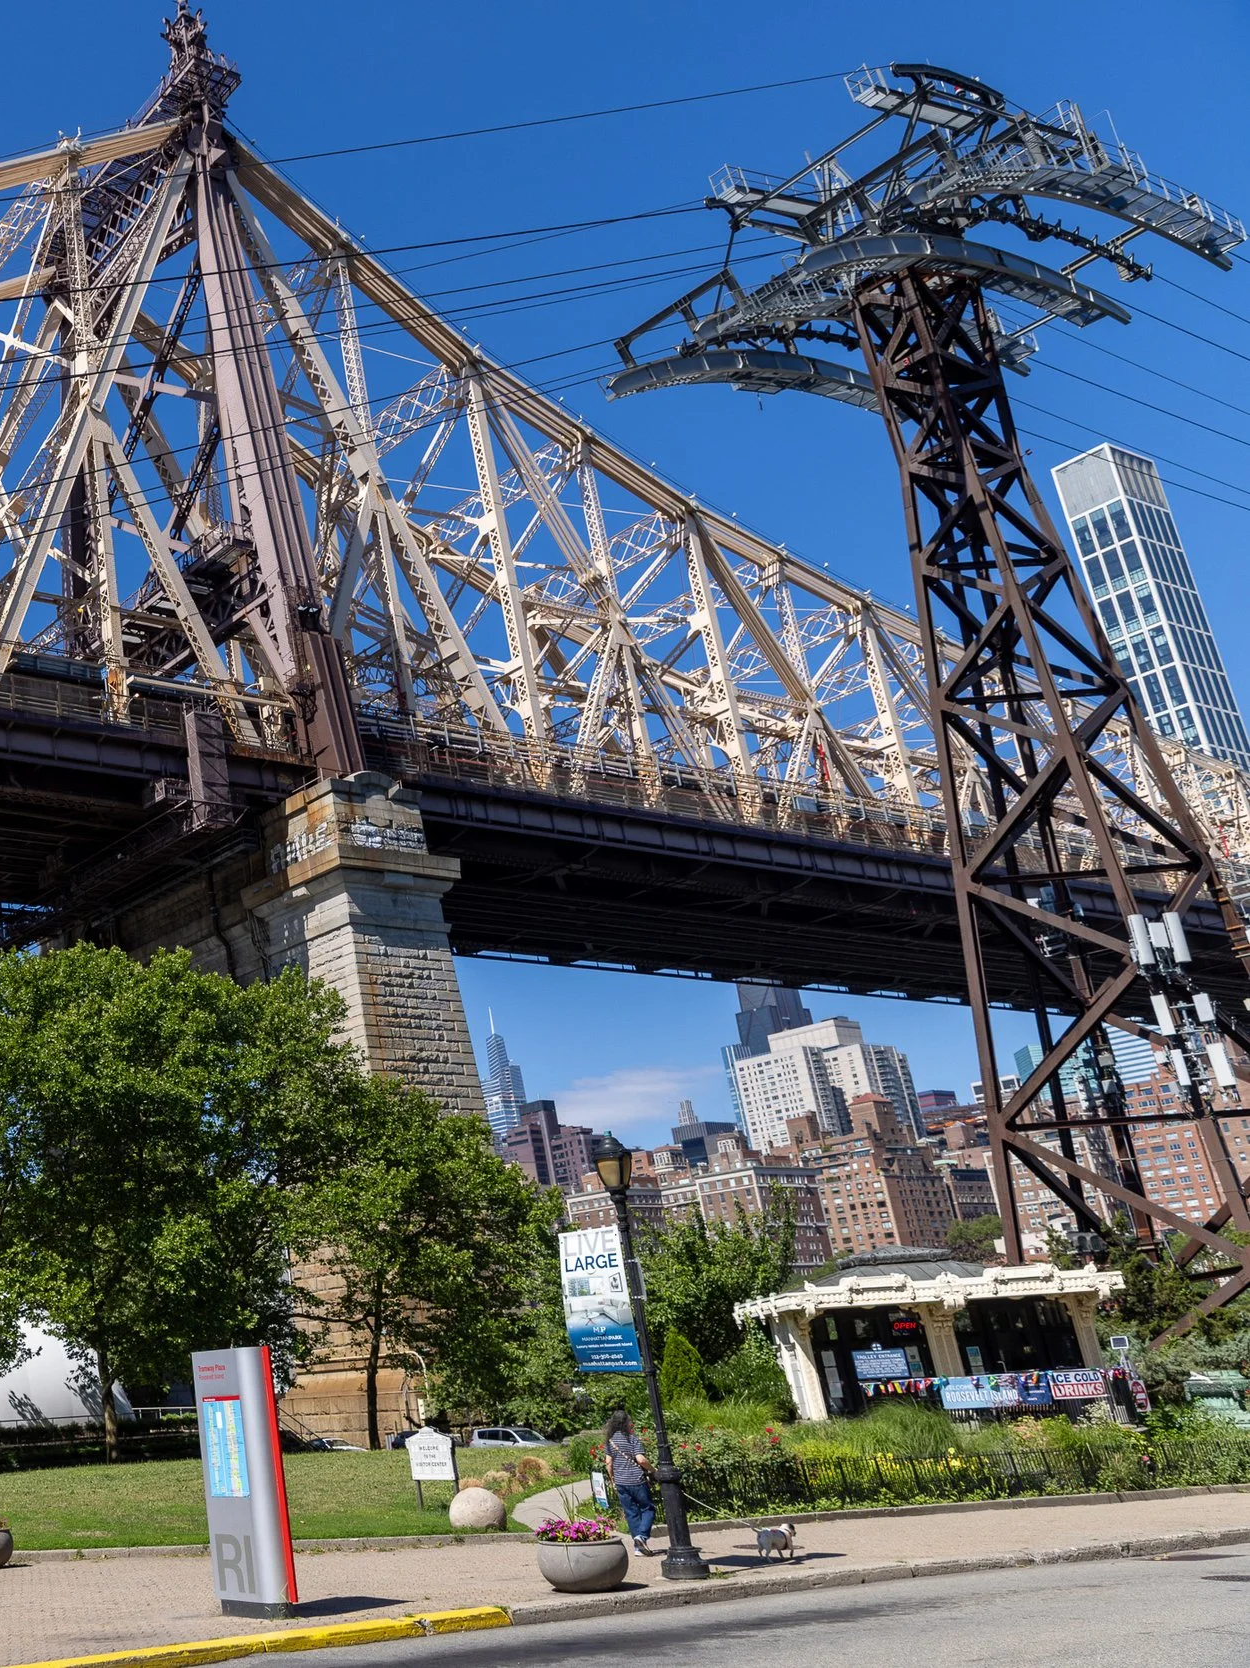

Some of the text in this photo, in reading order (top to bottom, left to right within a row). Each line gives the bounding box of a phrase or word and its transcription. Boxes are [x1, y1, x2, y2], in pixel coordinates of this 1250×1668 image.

[563, 1230, 616, 1257] LIVE
[565, 1253, 619, 1273] LARGE
[893, 1322, 917, 1330] OPEN
[1074, 1371, 1100, 1382] COLD
[946, 1389, 988, 1402] ROOSEVELT
[990, 1389, 1018, 1401] ISLAND
[1054, 1382, 1104, 1397] DRINKS
[214, 1533, 256, 1594] RI
